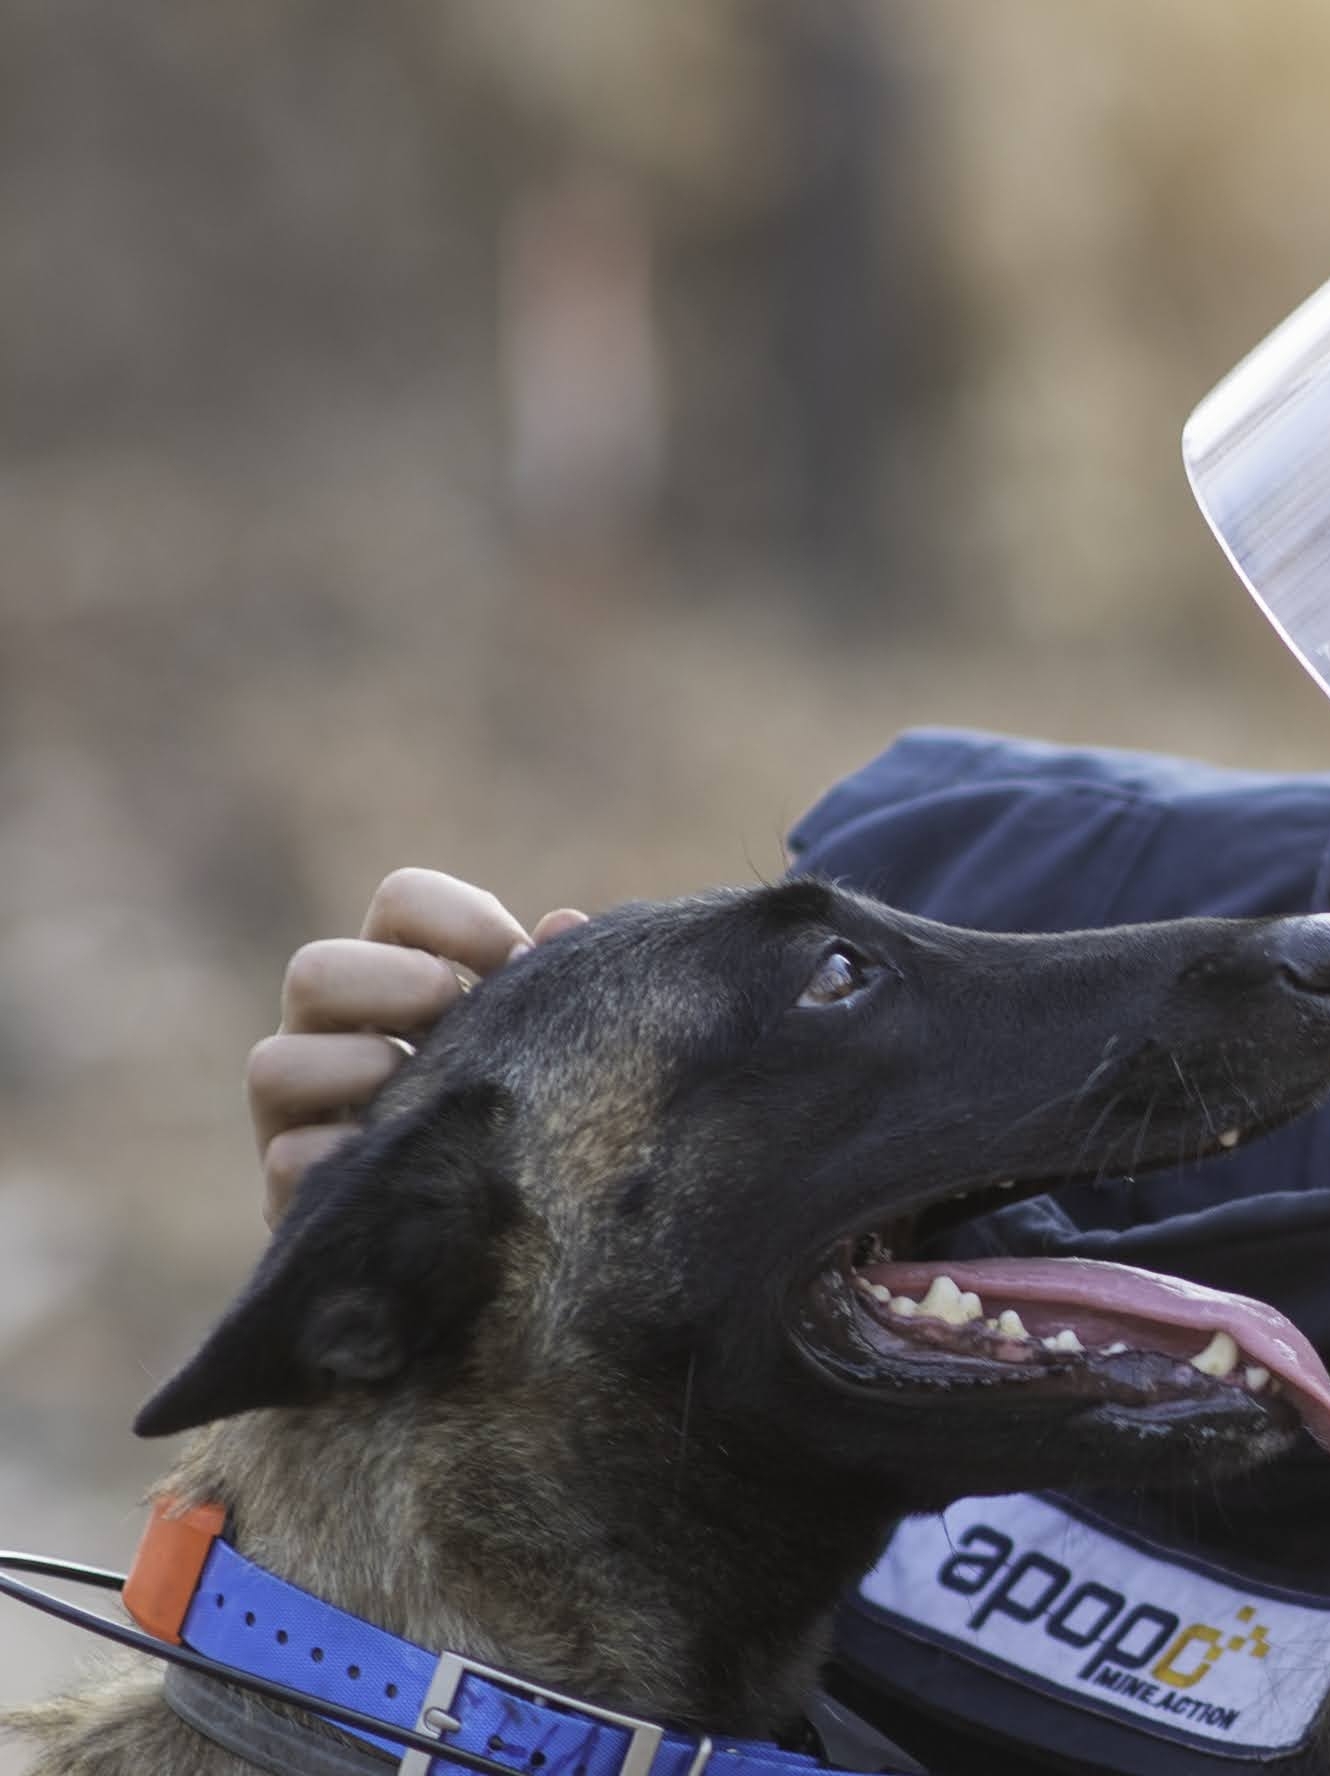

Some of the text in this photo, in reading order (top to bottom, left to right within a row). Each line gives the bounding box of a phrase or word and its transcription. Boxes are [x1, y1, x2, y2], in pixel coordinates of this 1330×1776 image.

[938, 1525, 1223, 1688] apopo
[1094, 1666, 1239, 1730] MINE ACTION
